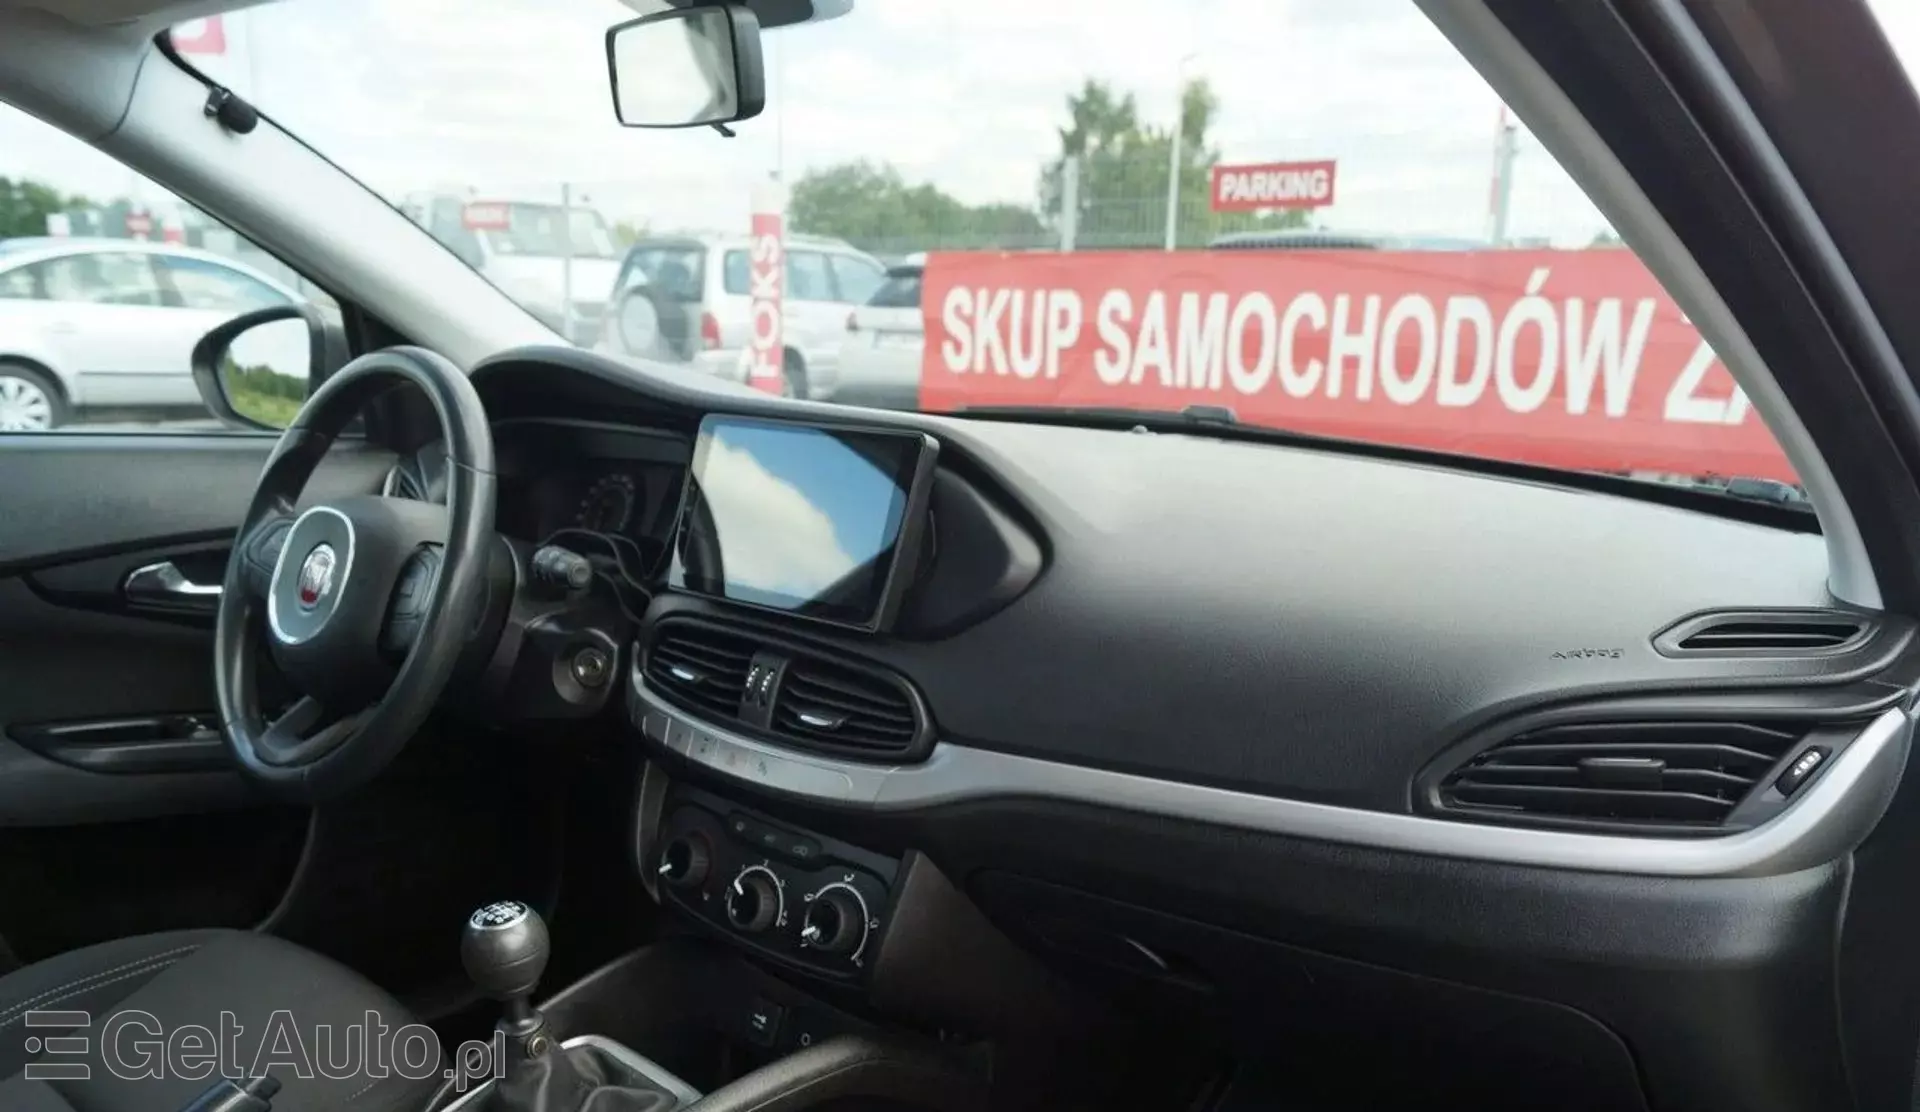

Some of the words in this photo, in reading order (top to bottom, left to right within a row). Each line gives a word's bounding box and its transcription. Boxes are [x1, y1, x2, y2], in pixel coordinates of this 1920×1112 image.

[1219, 168, 1329, 202] PARKING
[748, 232, 782, 378] FOKS
[941, 286, 1083, 379] SKUP
[1094, 267, 1657, 418] SAMOCHODÓW
[1663, 309, 1753, 426] Z
